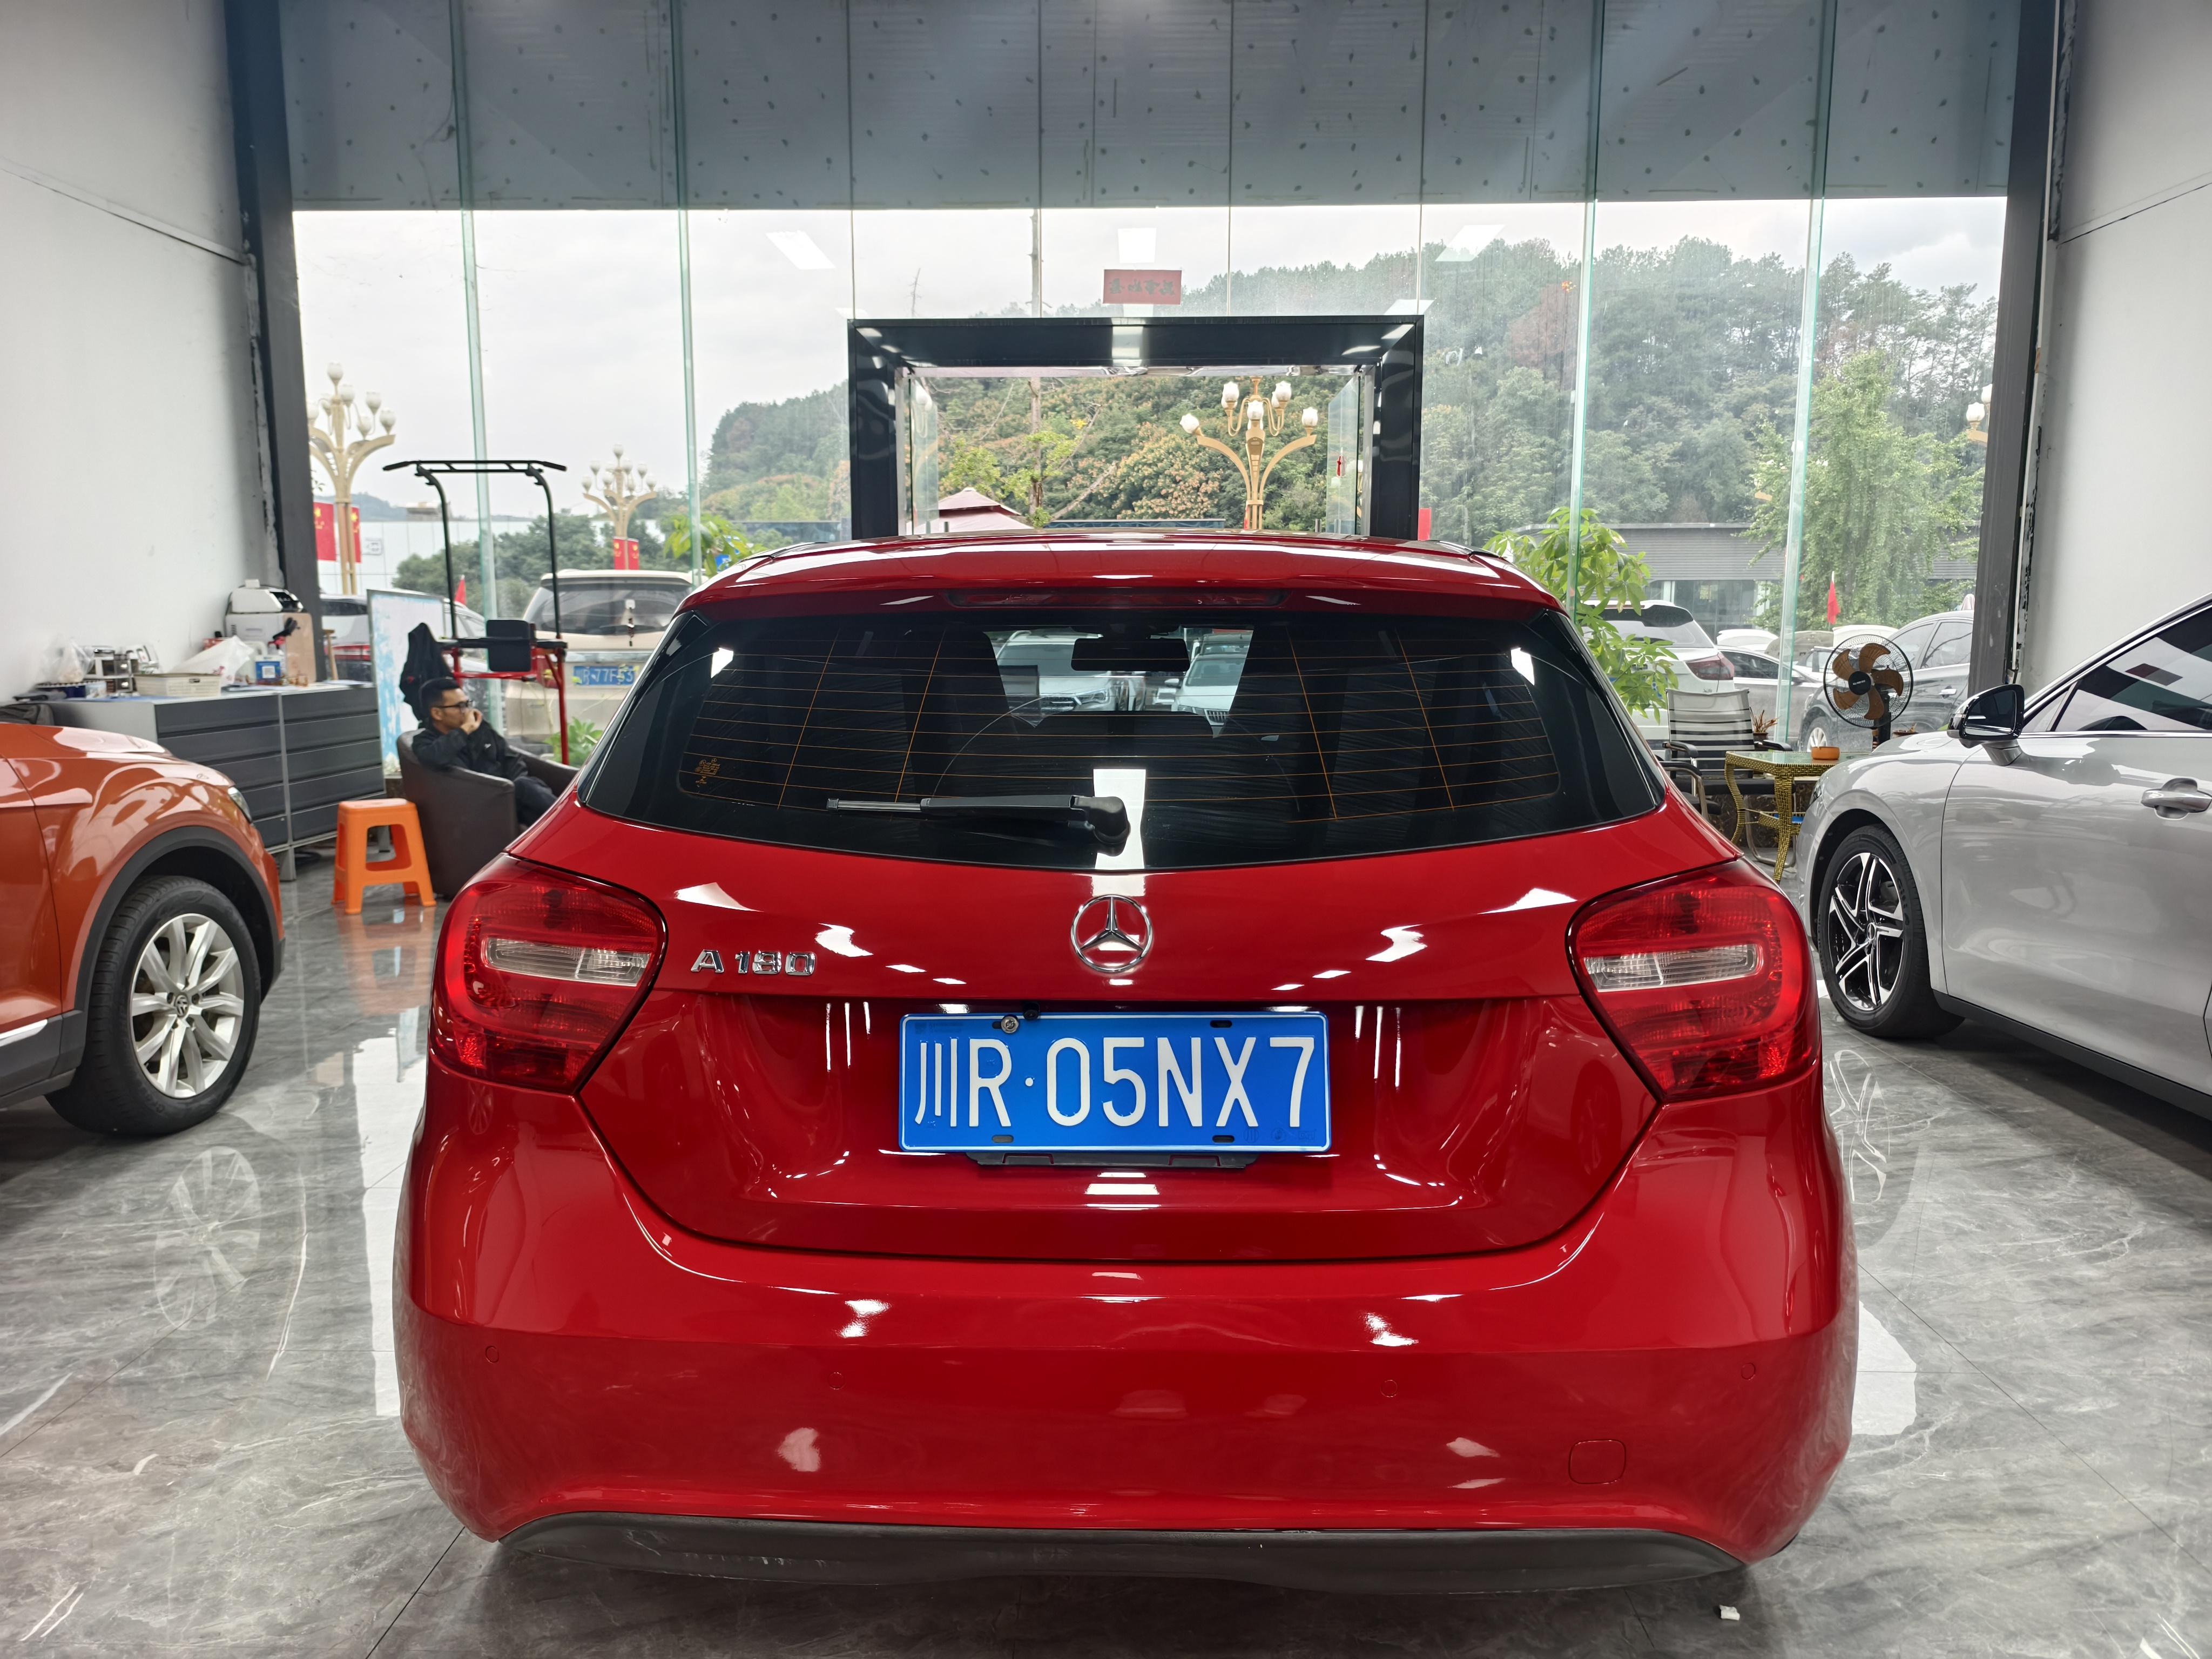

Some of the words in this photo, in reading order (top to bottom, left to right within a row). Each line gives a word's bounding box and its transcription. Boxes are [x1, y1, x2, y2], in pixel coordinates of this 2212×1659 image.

[690, 949, 724, 974] A
[734, 950, 817, 976] 180
[915, 1036, 1316, 1128] 川R·05NX7
